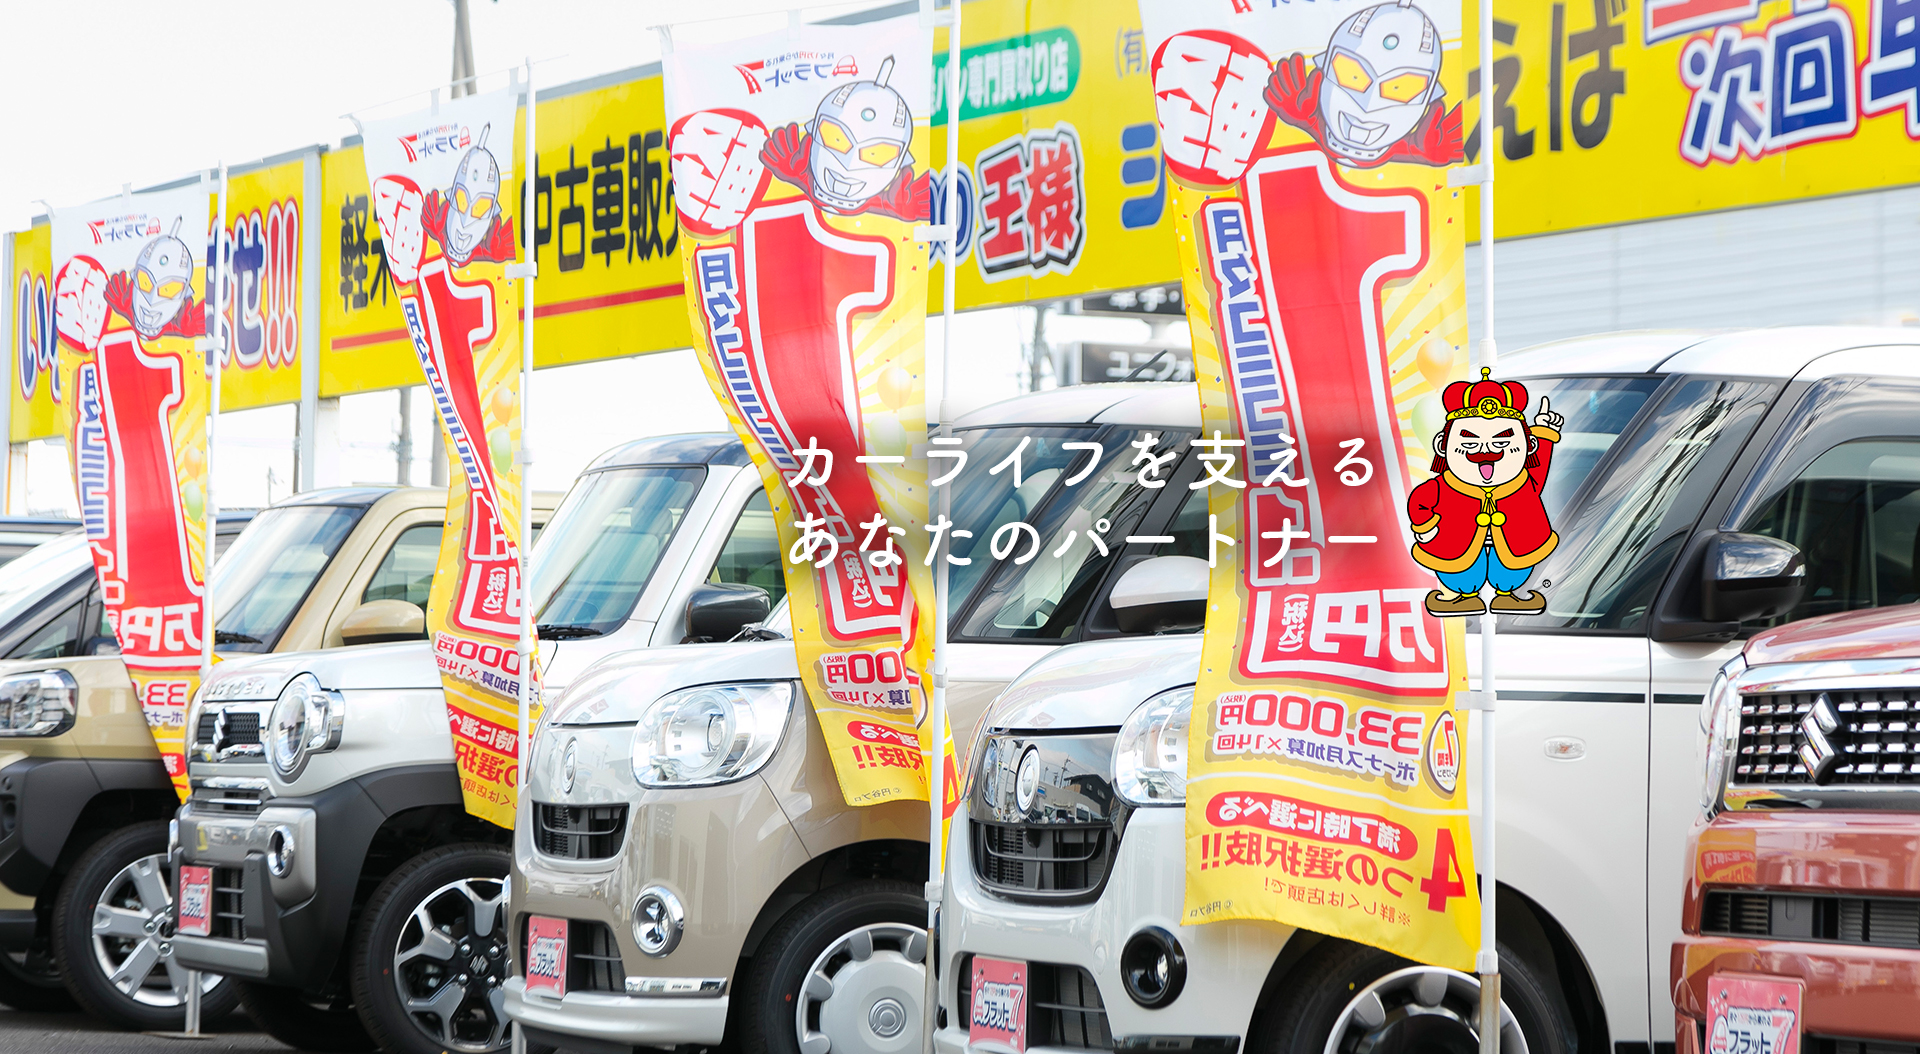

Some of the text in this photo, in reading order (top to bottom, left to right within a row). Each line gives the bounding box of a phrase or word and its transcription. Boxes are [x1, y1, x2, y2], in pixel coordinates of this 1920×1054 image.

[520, 130, 677, 279] 中古車販
[930, 127, 1082, 274] の王様
